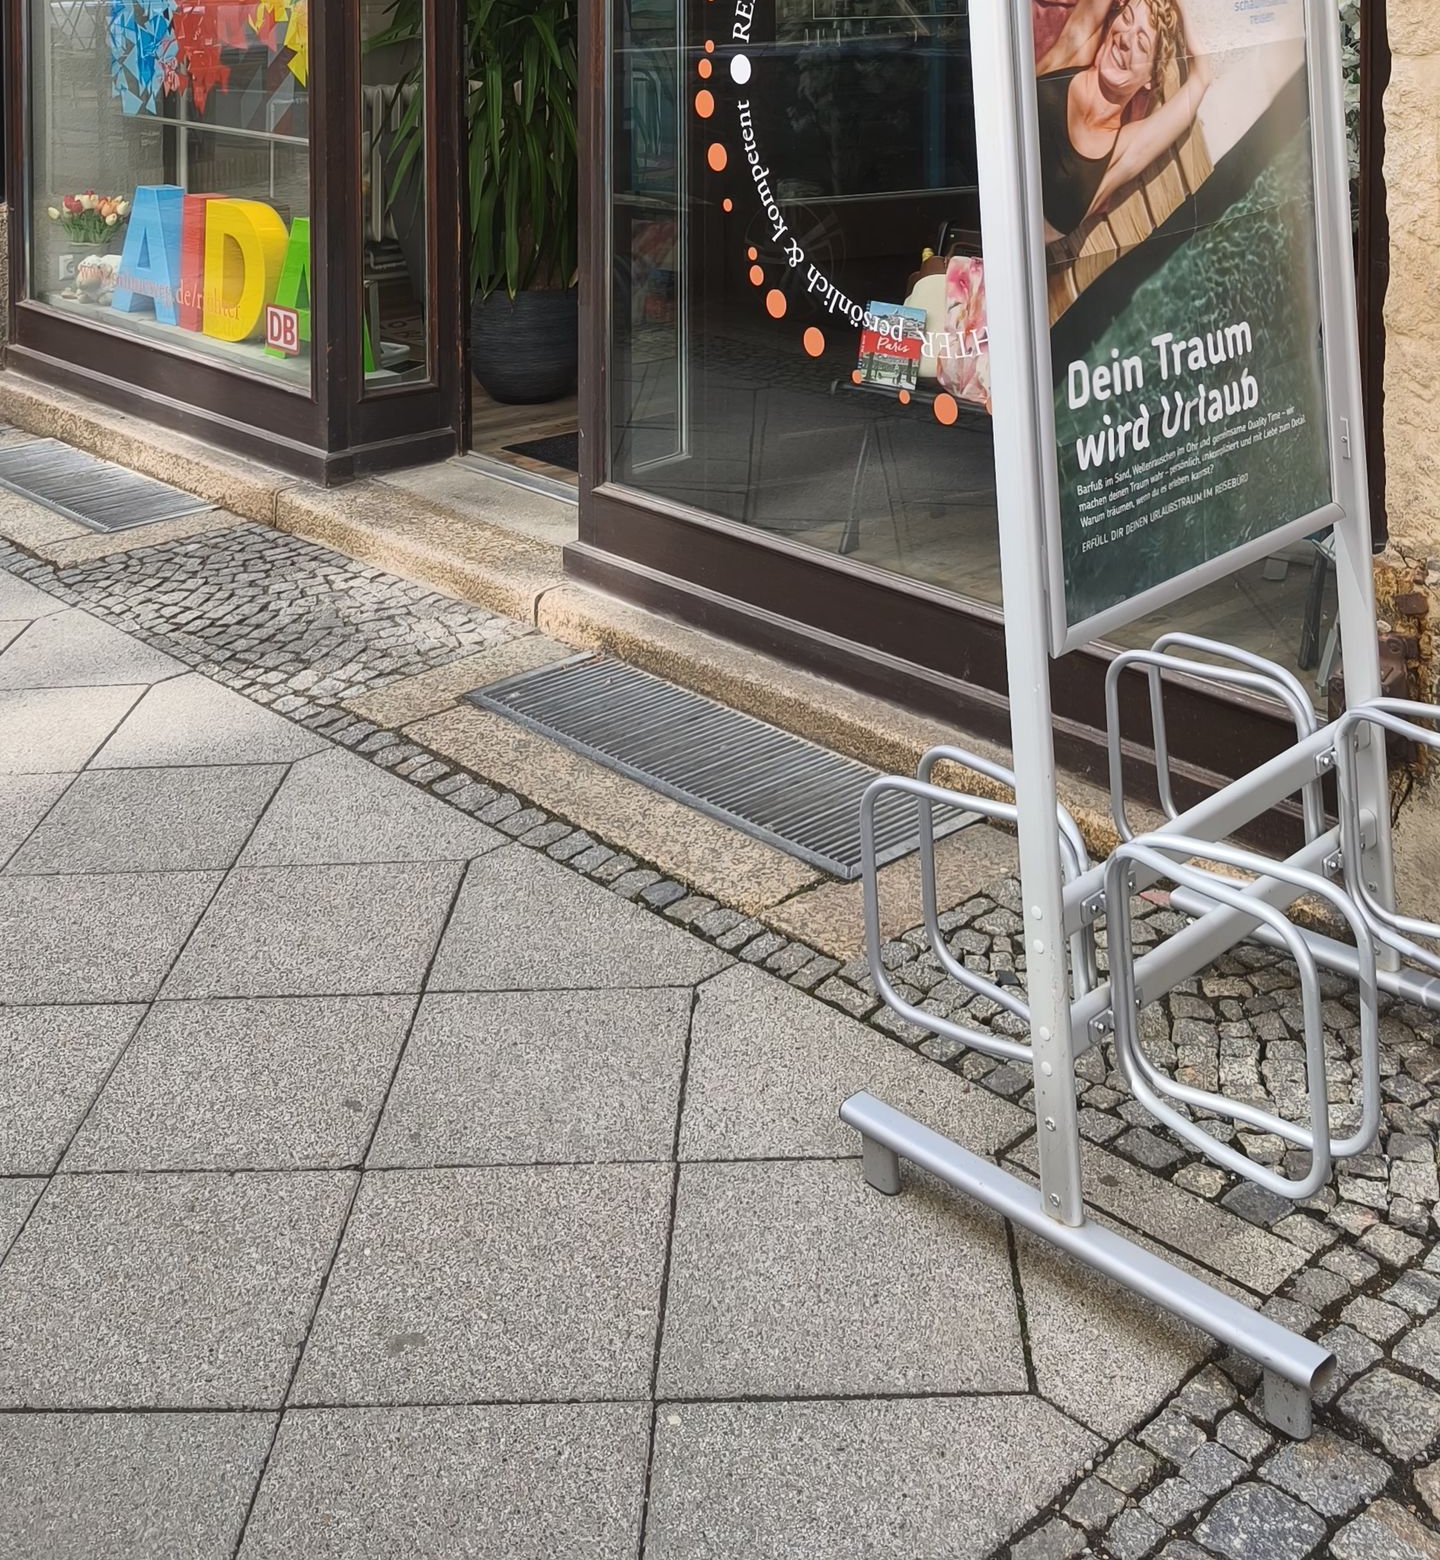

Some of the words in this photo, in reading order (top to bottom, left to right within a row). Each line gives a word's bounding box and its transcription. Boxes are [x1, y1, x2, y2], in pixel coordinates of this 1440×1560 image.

[737, 99, 788, 242] kompetent
[784, 238, 804, 267] &
[806, 263, 905, 343] persönlich
[269, 311, 295, 346] DB
[877, 336, 910, 353] Paris
[917, 326, 989, 359] HTER
[1067, 348, 1144, 410] Dein
[1151, 321, 1253, 380] Traum
[1076, 403, 1150, 471] wird
[1161, 367, 1259, 439] Urlaub
[1077, 479, 1103, 496] Barfuß
[1114, 468, 1132, 483] Sand,
[1186, 440, 1199, 453] Ohr
[1247, 417, 1267, 431] Quality
[1079, 495, 1107, 512] machen
[1109, 487, 1129, 502] deinen
[1130, 479, 1149, 493] Traum
[1080, 512, 1105, 528] Warum
[1082, 533, 1108, 553] ERFÜLL
[1111, 527, 1123, 541] DIR
[1126, 515, 1148, 535] DEINEN
[1204, 488, 1213, 499] IM
